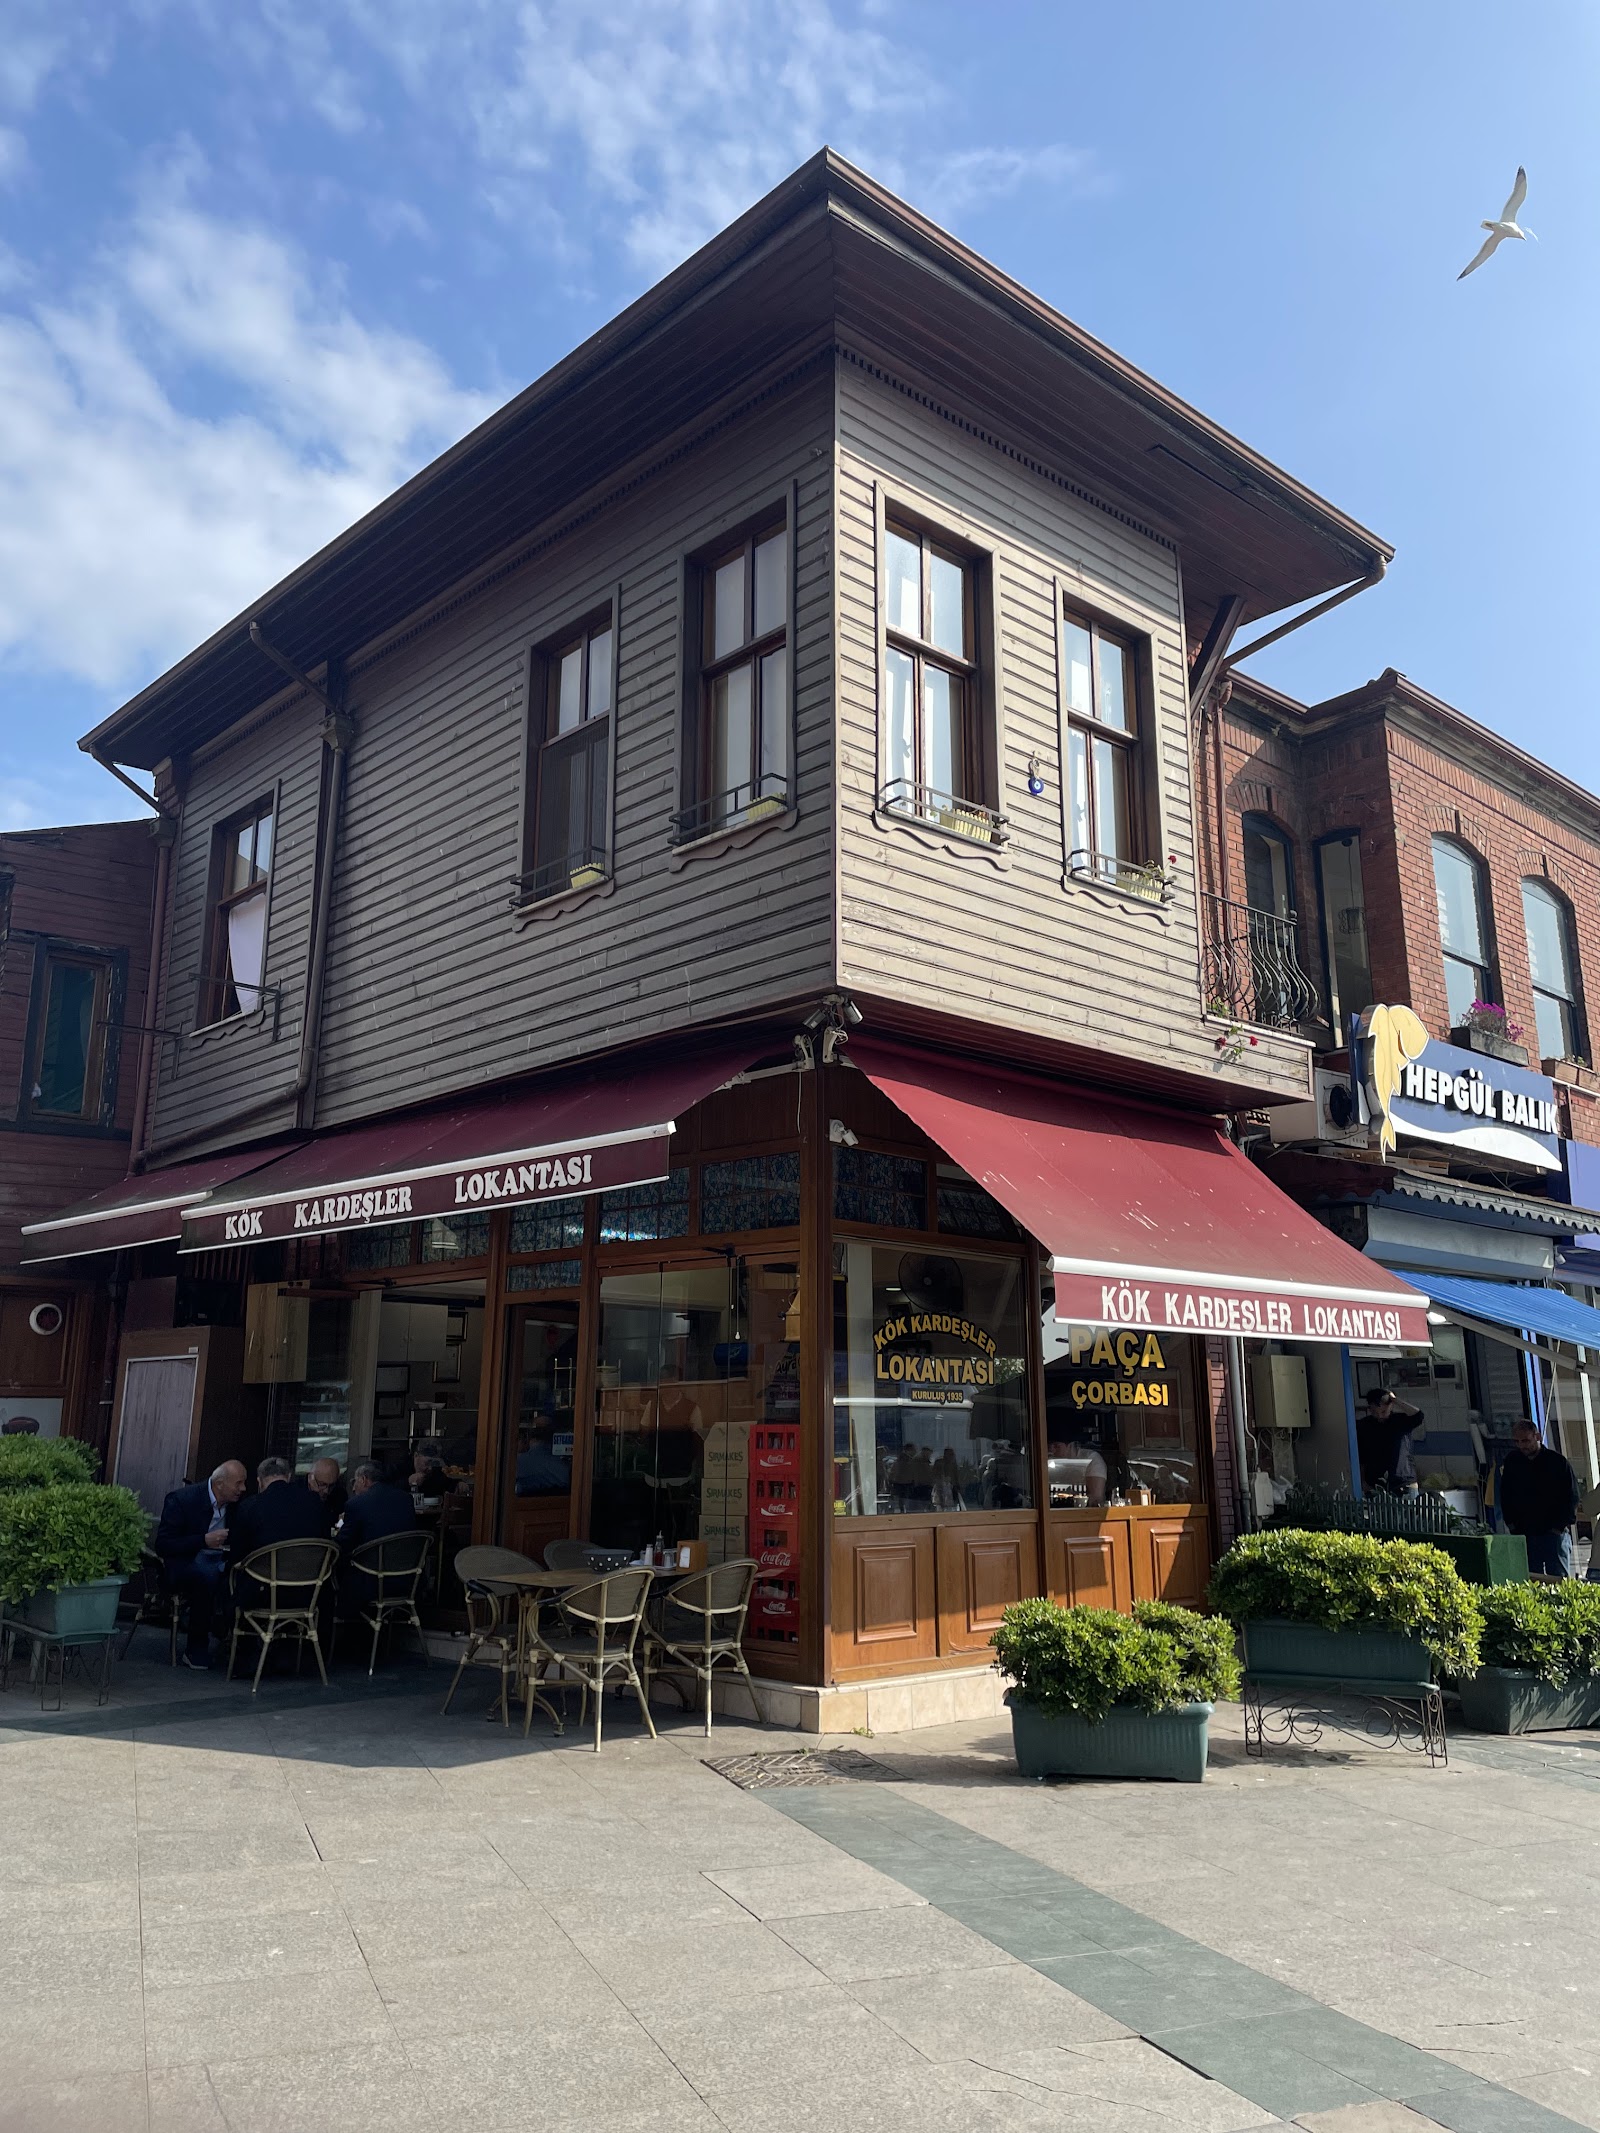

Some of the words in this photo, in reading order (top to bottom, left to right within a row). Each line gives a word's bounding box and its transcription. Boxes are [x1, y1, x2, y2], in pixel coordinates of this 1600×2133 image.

[1406, 1063, 1496, 1119] HEPGÜL
[1502, 1090, 1558, 1135] BALIK
[225, 1209, 263, 1240] KÖK
[293, 1186, 413, 1224] KARDEŞLER
[454, 1154, 593, 1203] LOKANTASI
[1101, 1281, 1151, 1323] KÖK
[1304, 1304, 1402, 1341] LOKANTASI
[873, 1316, 908, 1352] KÖK
[911, 1314, 997, 1359] KARDEŞLER
[1070, 1327, 1166, 1376] PAÇA
[876, 1354, 994, 1385] LOKANTASI
[912, 1390, 946, 1404] KURULUŞ
[947, 1392, 963, 1402] 1935
[1071, 1380, 1169, 1410] ÇORBASI
